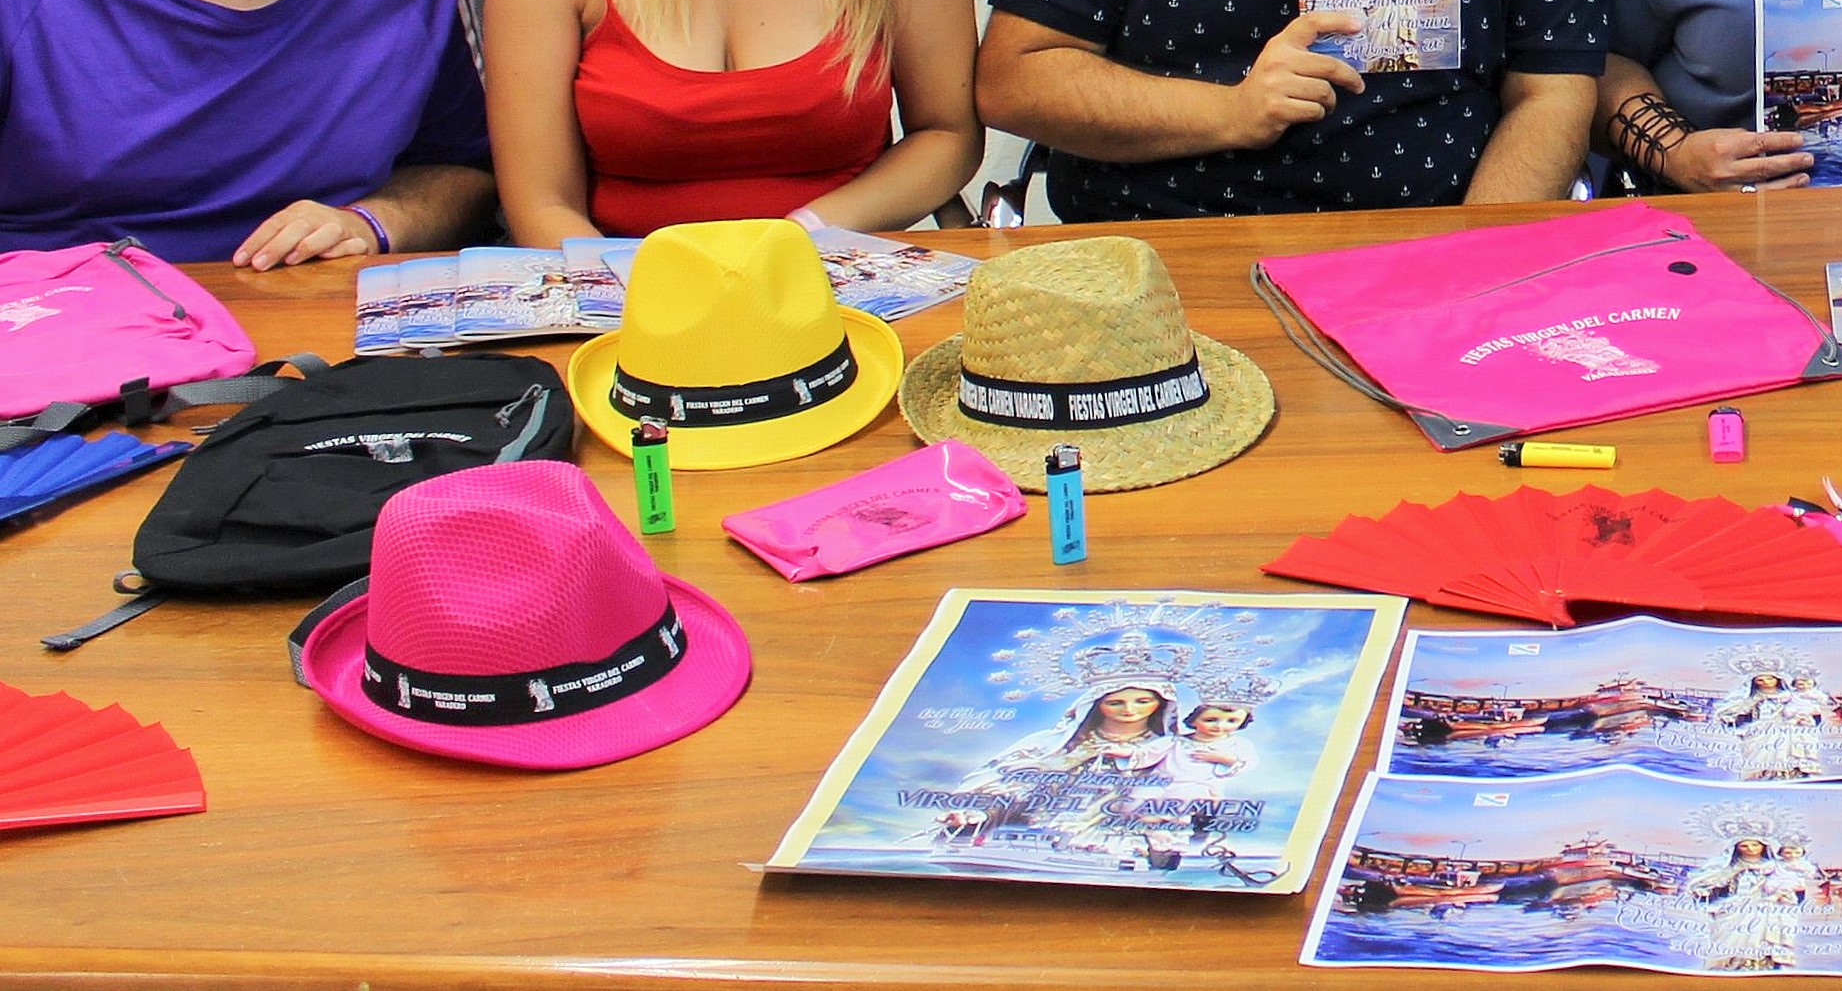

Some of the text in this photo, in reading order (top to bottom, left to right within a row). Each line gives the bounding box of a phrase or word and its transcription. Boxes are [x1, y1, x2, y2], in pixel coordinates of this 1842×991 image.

[1460, 307, 1682, 366] FIESTAS VIRGEN DEL CARMEN
[1014, 393, 1054, 421] VARADERO
[1068, 392, 1105, 421] FIESTAS
[1104, 387, 1140, 419] VIRGEN
[1139, 386, 1155, 413] DEL
[553, 655, 645, 695] FIESTAS VIRGEN DEL CARMEN
[586, 676, 623, 693] VARADERO
[467, 693, 495, 703] CARMEN
[999, 767, 1173, 787] Fiestas Patronales
[897, 789, 1265, 819] VIRGEN DEL CARMEN
[1202, 817, 1258, 833] 2018
